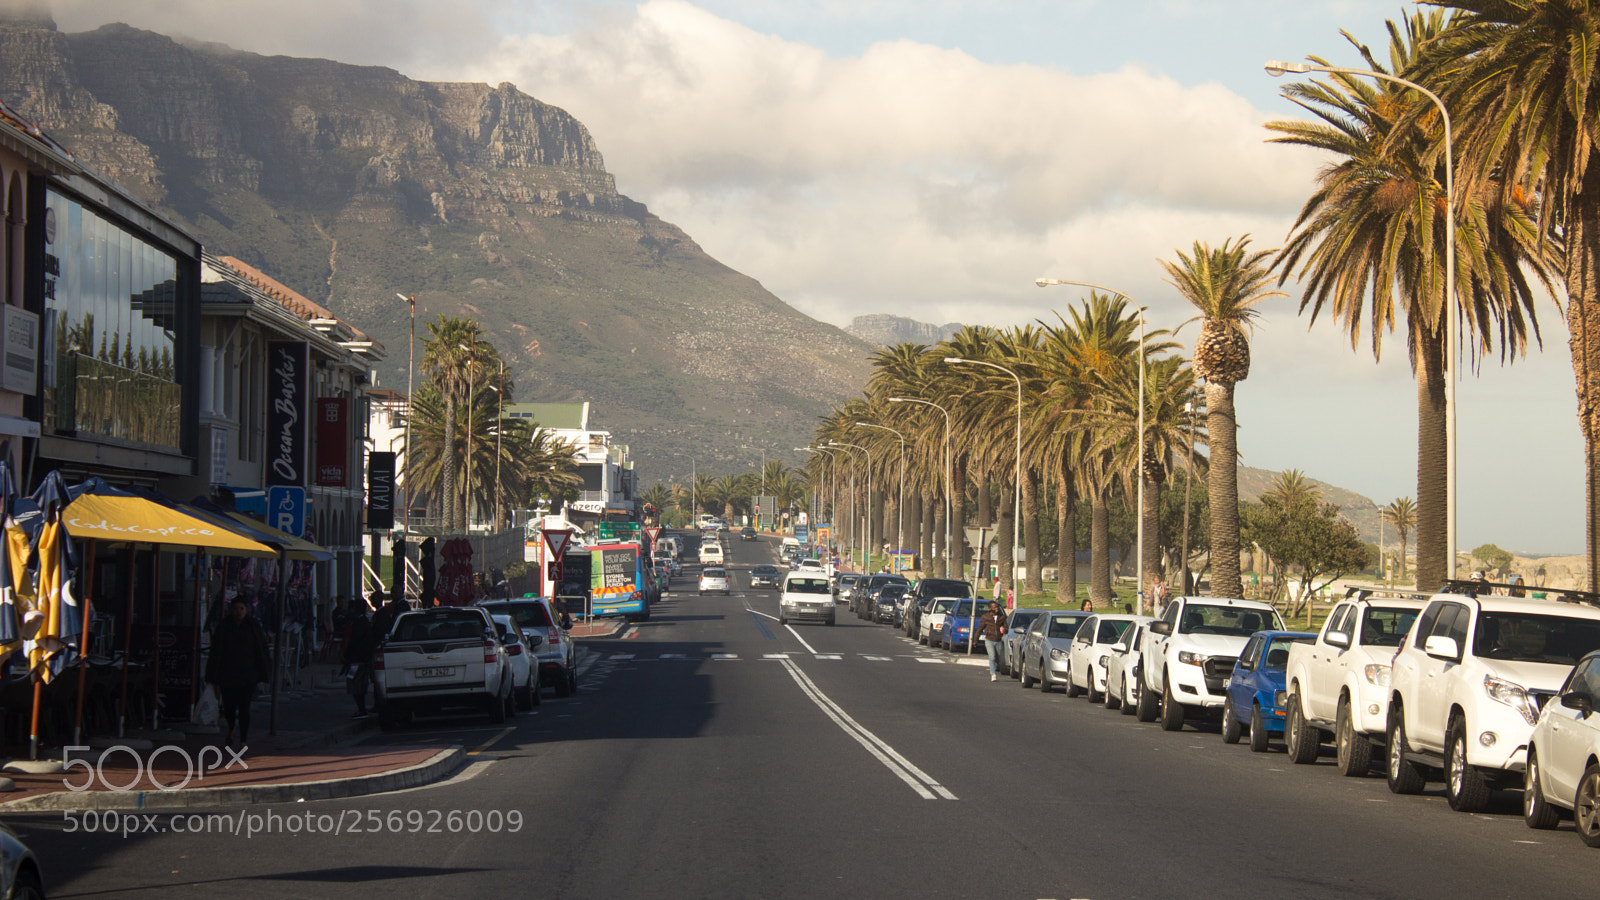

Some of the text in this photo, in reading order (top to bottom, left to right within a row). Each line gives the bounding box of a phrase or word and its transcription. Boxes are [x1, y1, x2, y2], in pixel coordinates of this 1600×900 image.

[273, 348, 297, 480] Ocean Basket
[321, 466, 342, 476] vida
[372, 470, 390, 510] KAUAI
[277, 512, 294, 534] R
